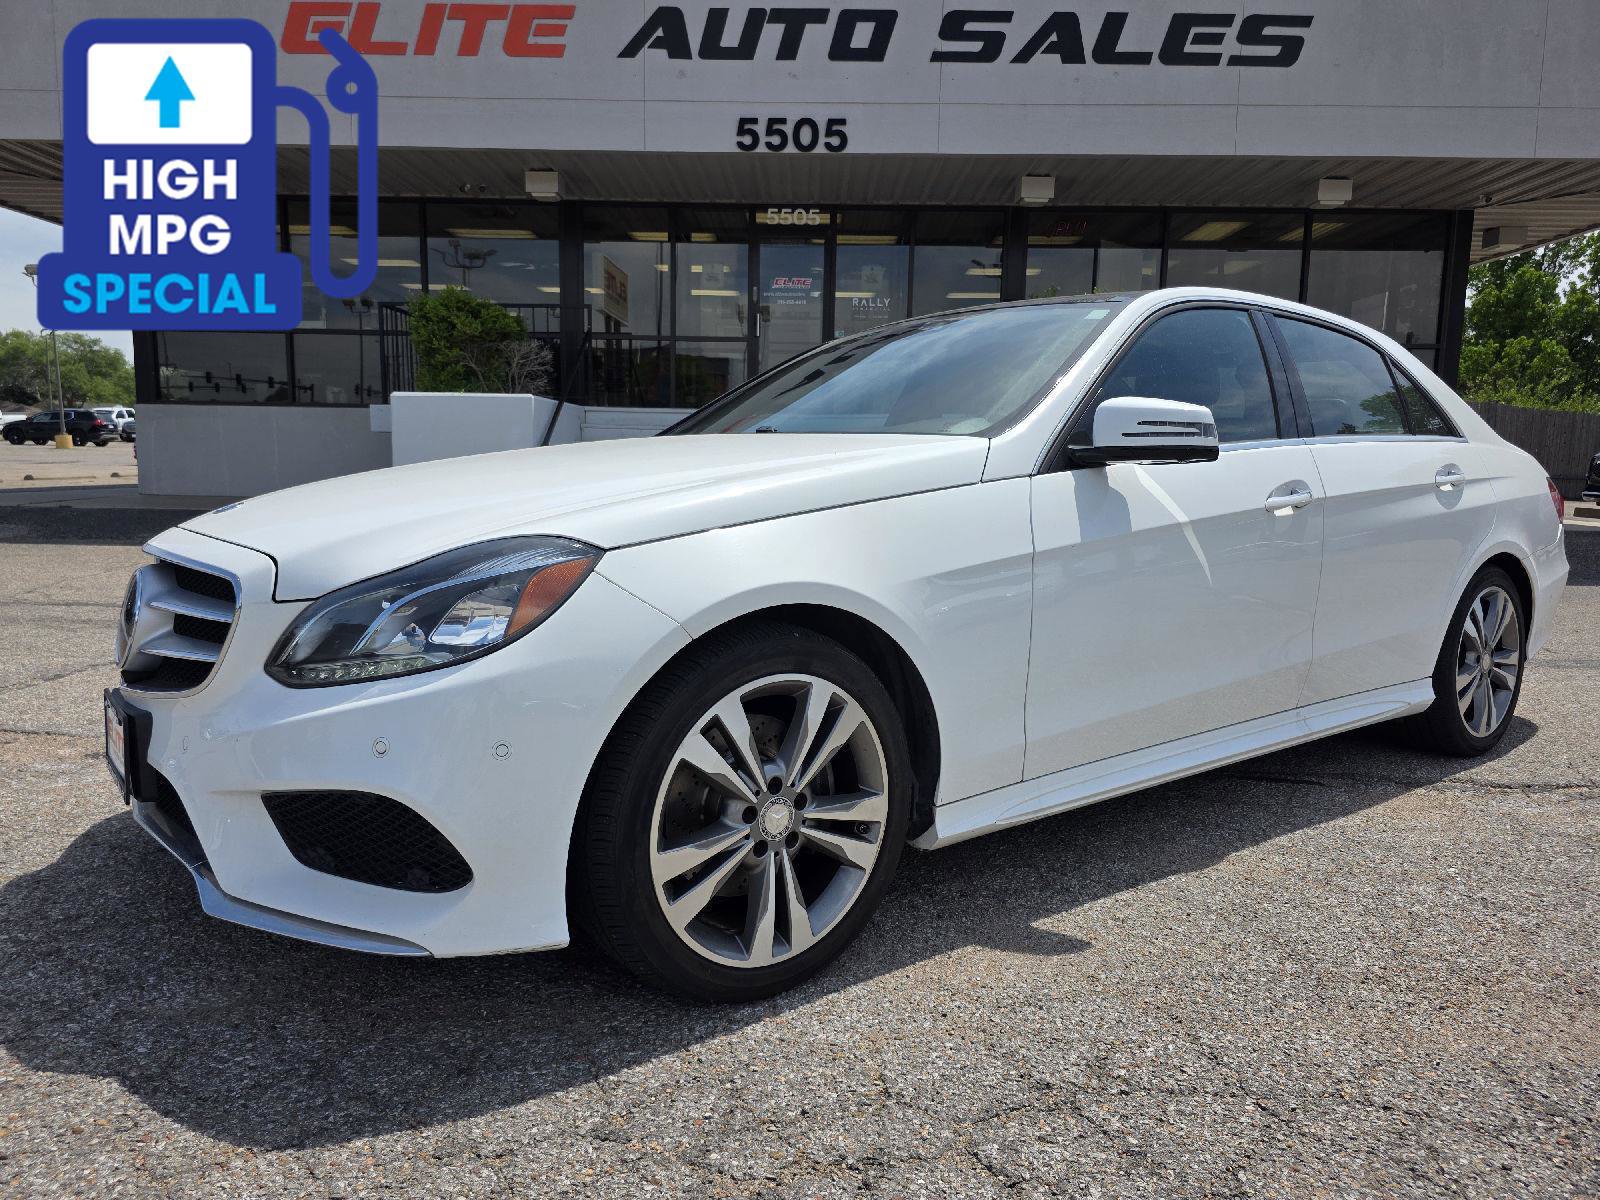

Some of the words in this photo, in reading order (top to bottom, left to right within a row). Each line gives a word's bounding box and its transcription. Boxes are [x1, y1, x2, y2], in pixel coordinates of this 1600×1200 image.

[280, 1, 576, 58] ELITE
[617, 6, 899, 62] AUTO
[930, 9, 1315, 68] SALES
[736, 117, 848, 152] 5505
[766, 208, 821, 225] 5505
[773, 277, 812, 287] ELITE
[852, 298, 891, 307] RALLY
